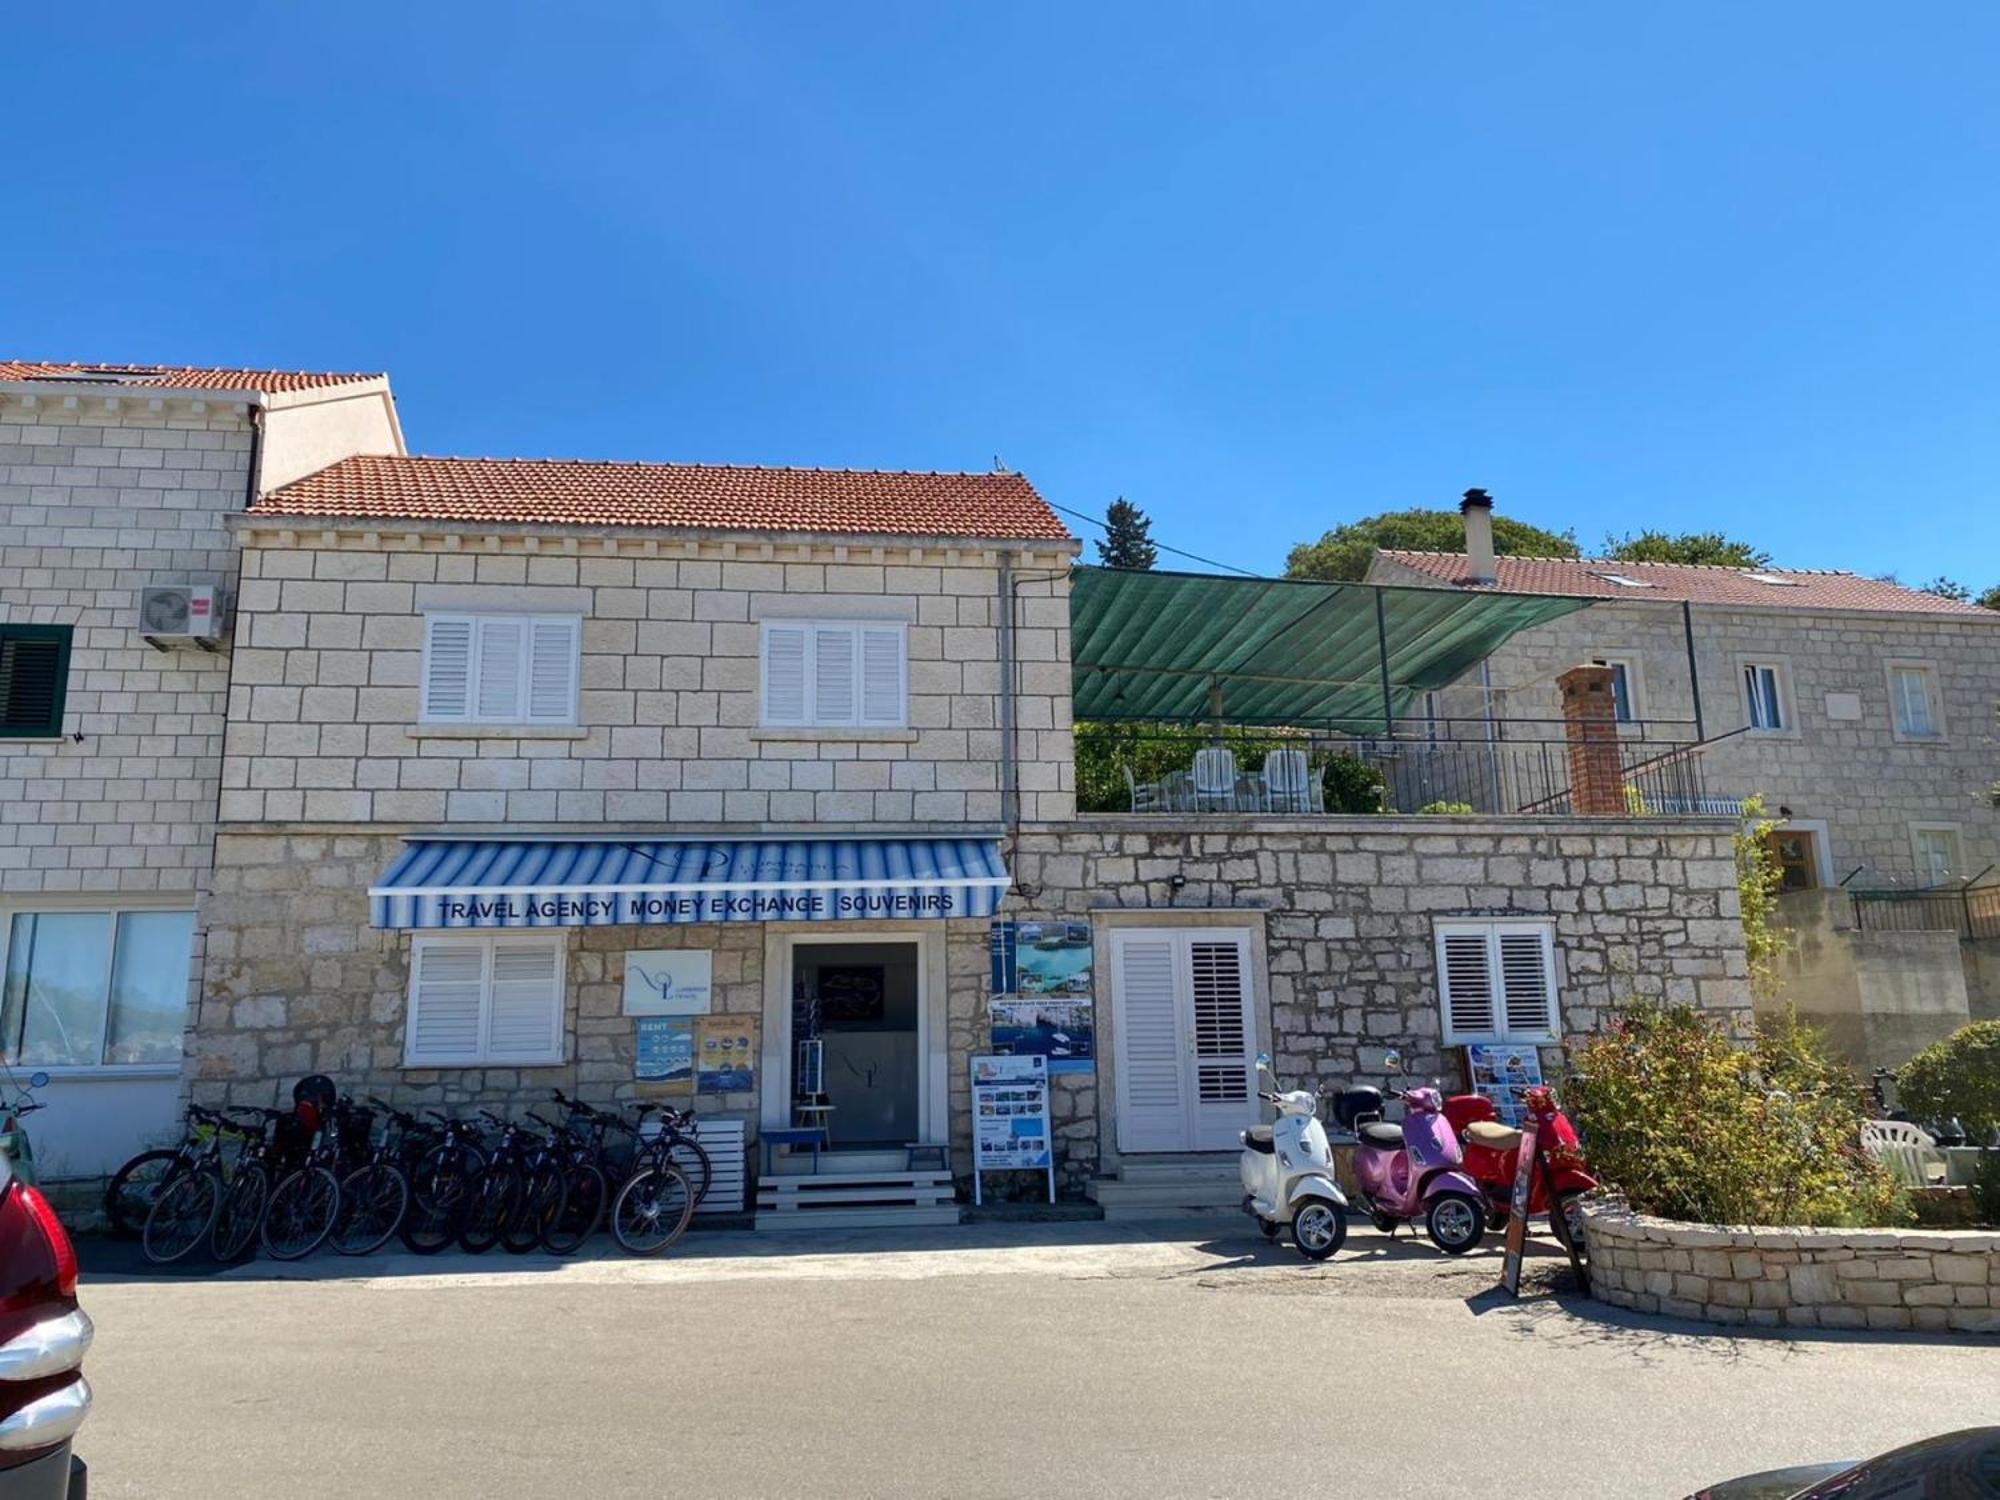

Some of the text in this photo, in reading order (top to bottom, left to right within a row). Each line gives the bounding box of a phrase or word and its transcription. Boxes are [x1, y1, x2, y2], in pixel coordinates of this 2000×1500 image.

[438, 894, 954, 919] TRAVEL AGENCY MONEY EXCHANGE SOUVENIRS
